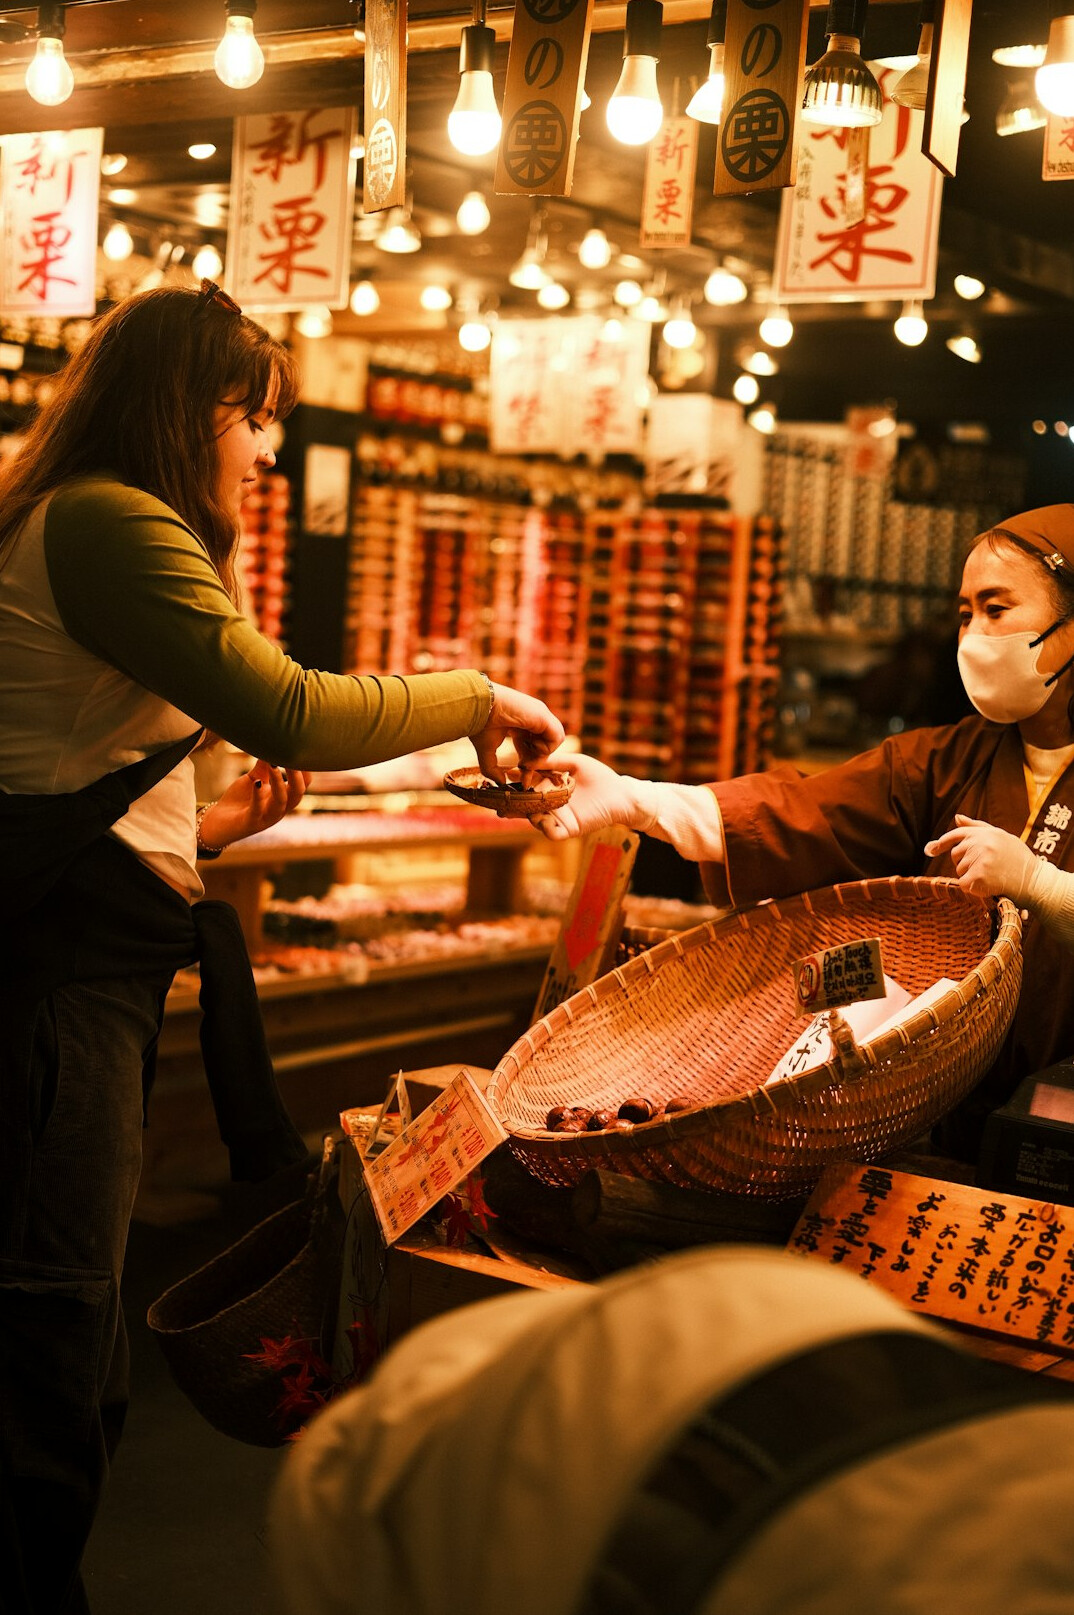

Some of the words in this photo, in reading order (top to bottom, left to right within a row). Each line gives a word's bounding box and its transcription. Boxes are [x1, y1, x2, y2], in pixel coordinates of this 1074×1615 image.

[248, 108, 343, 293] 新栗
[653, 127, 690, 225] 新栗
[823, 951, 843, 966] Don't
[842, 941, 872, 958] Touch
[890, 1192, 946, 1273] お楽しみ
[911, 1222, 960, 1303] おいしさを
[948, 1202, 1007, 1299] 栗本来の
[978, 1208, 1037, 1315] 広がる新しい
